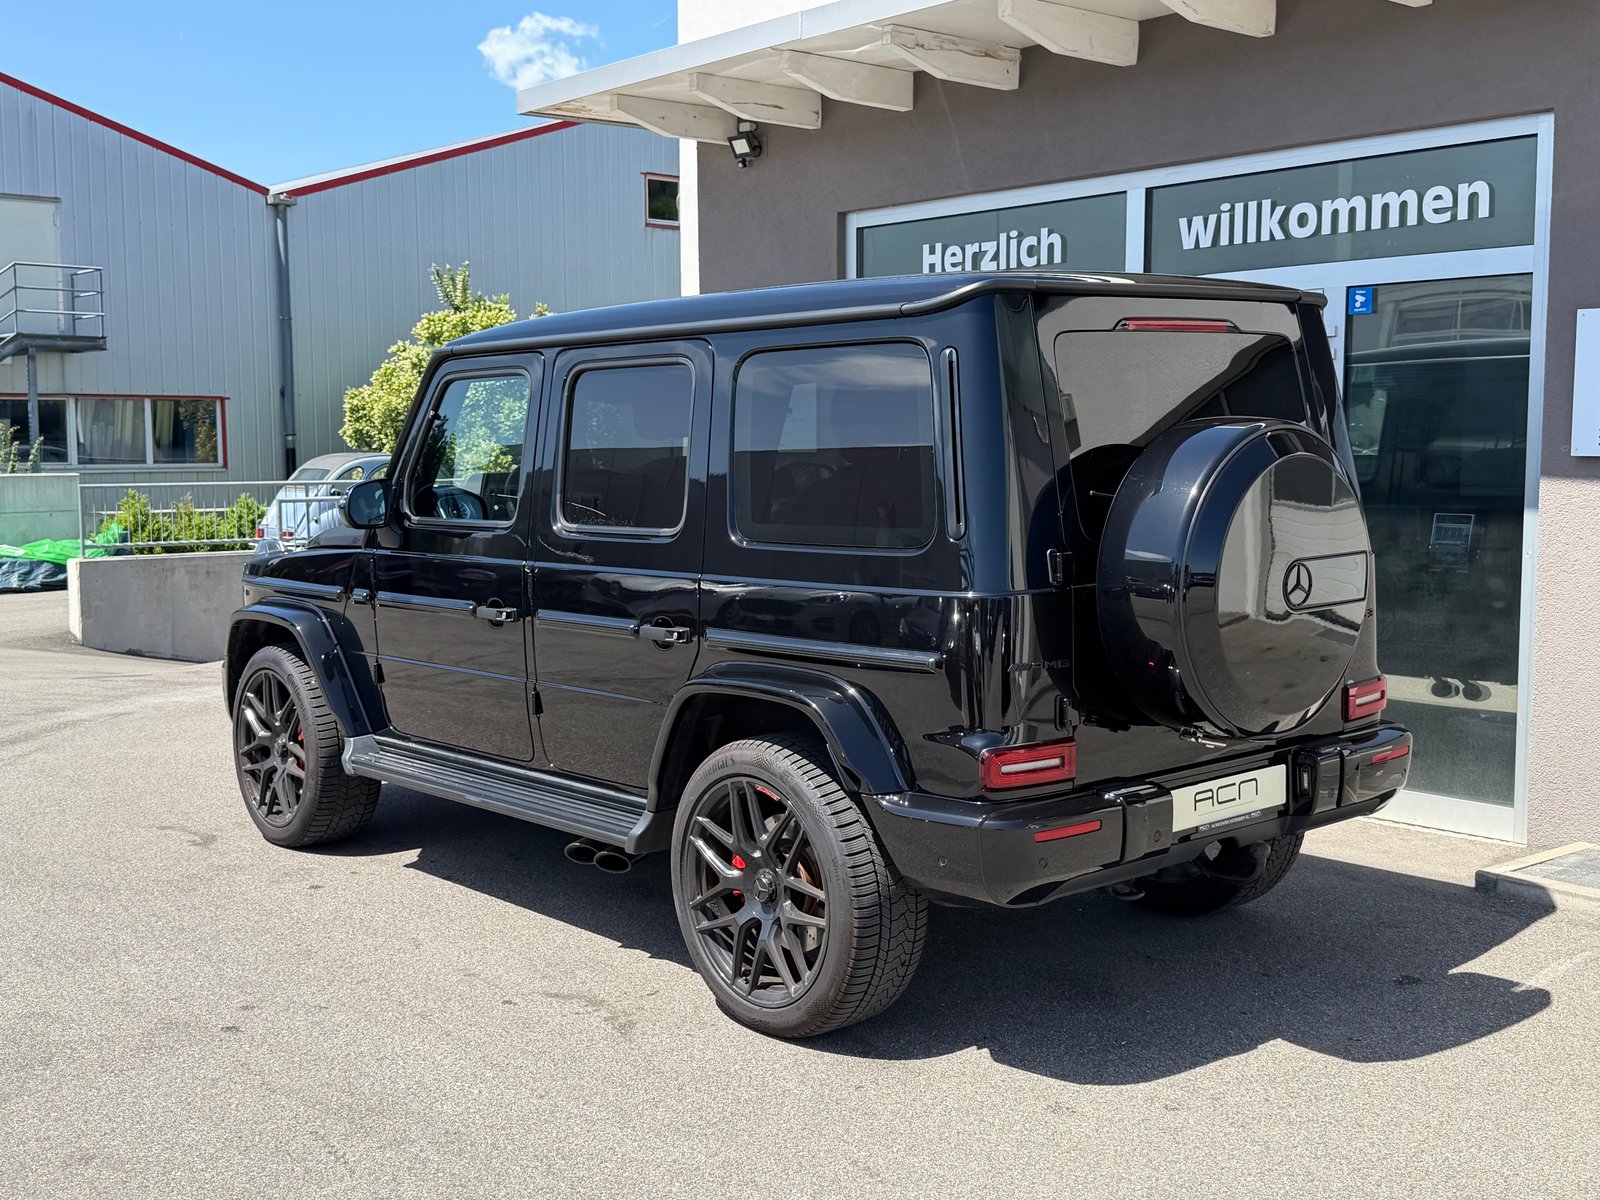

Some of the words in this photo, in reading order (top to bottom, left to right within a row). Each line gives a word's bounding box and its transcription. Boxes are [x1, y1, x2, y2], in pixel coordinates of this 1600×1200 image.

[923, 227, 1062, 274] Herzlich
[1178, 180, 1490, 250] willkommen
[1194, 778, 1258, 811] ACN
